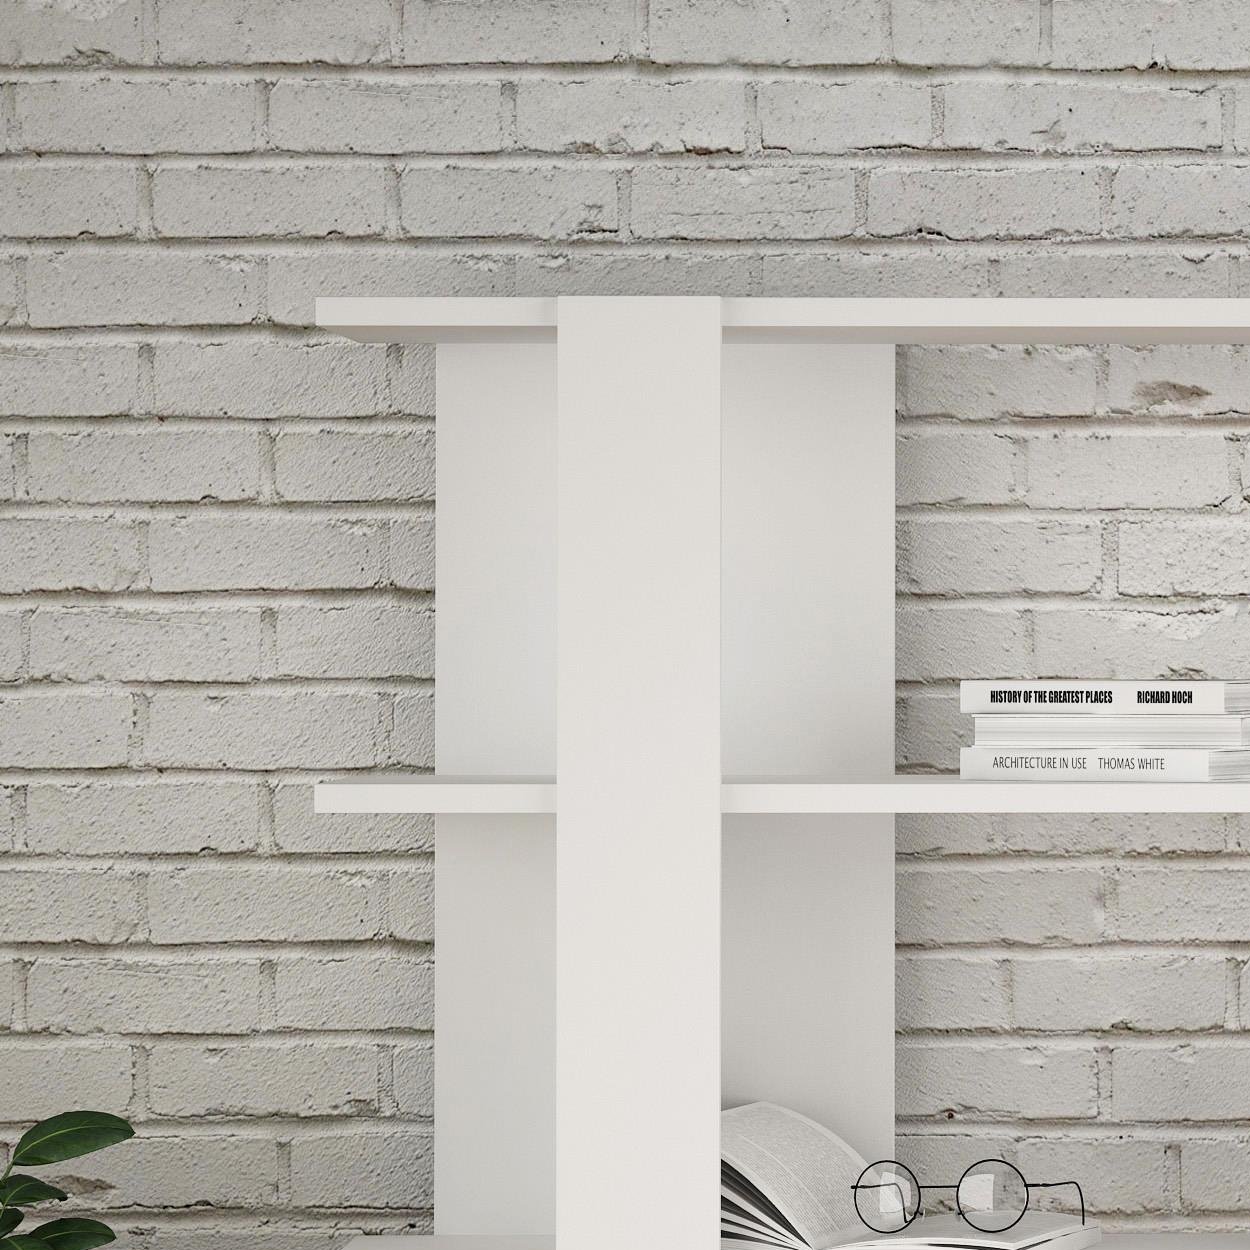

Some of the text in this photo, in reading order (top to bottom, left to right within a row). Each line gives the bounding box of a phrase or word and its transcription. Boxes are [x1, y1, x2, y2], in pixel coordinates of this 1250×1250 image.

[990, 690, 1113, 704] HISTORY OF THE GREATEST PLACES
[1137, 690, 1193, 704] RICHARD HOCH
[992, 756, 1087, 770] ARCHITECTURE IN USE
[1097, 757, 1165, 770] THOMAS WHITE
